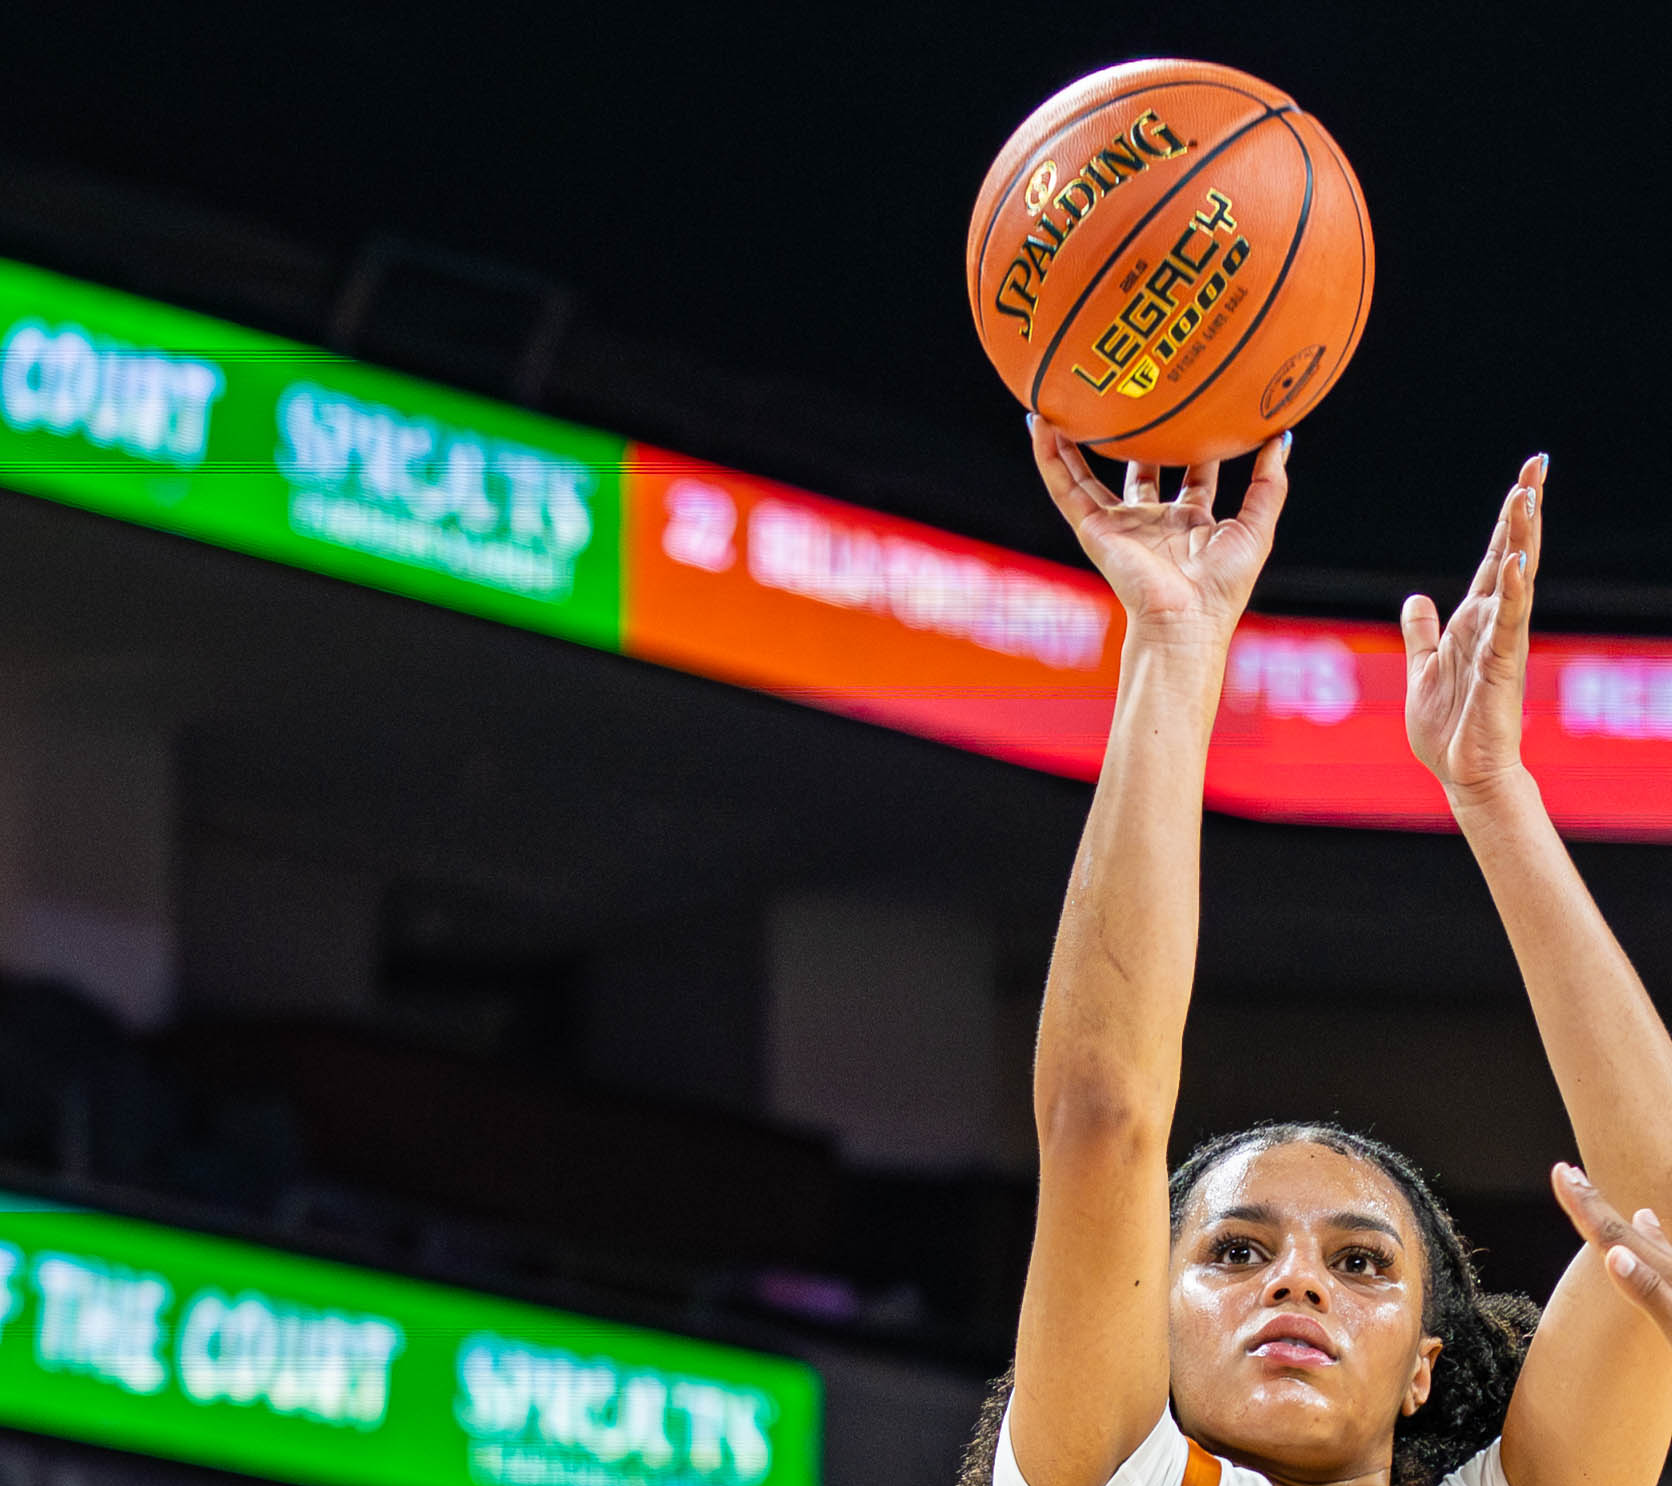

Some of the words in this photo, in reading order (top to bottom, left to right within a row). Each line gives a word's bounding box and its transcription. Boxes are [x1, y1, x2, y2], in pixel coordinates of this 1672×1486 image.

[995, 107, 1188, 343] SPALDING
[1072, 187, 1238, 396] LEGACY
[1152, 235, 1251, 365] 1000
[31, 1249, 171, 1394] THE
[179, 1287, 403, 1429] COURT
